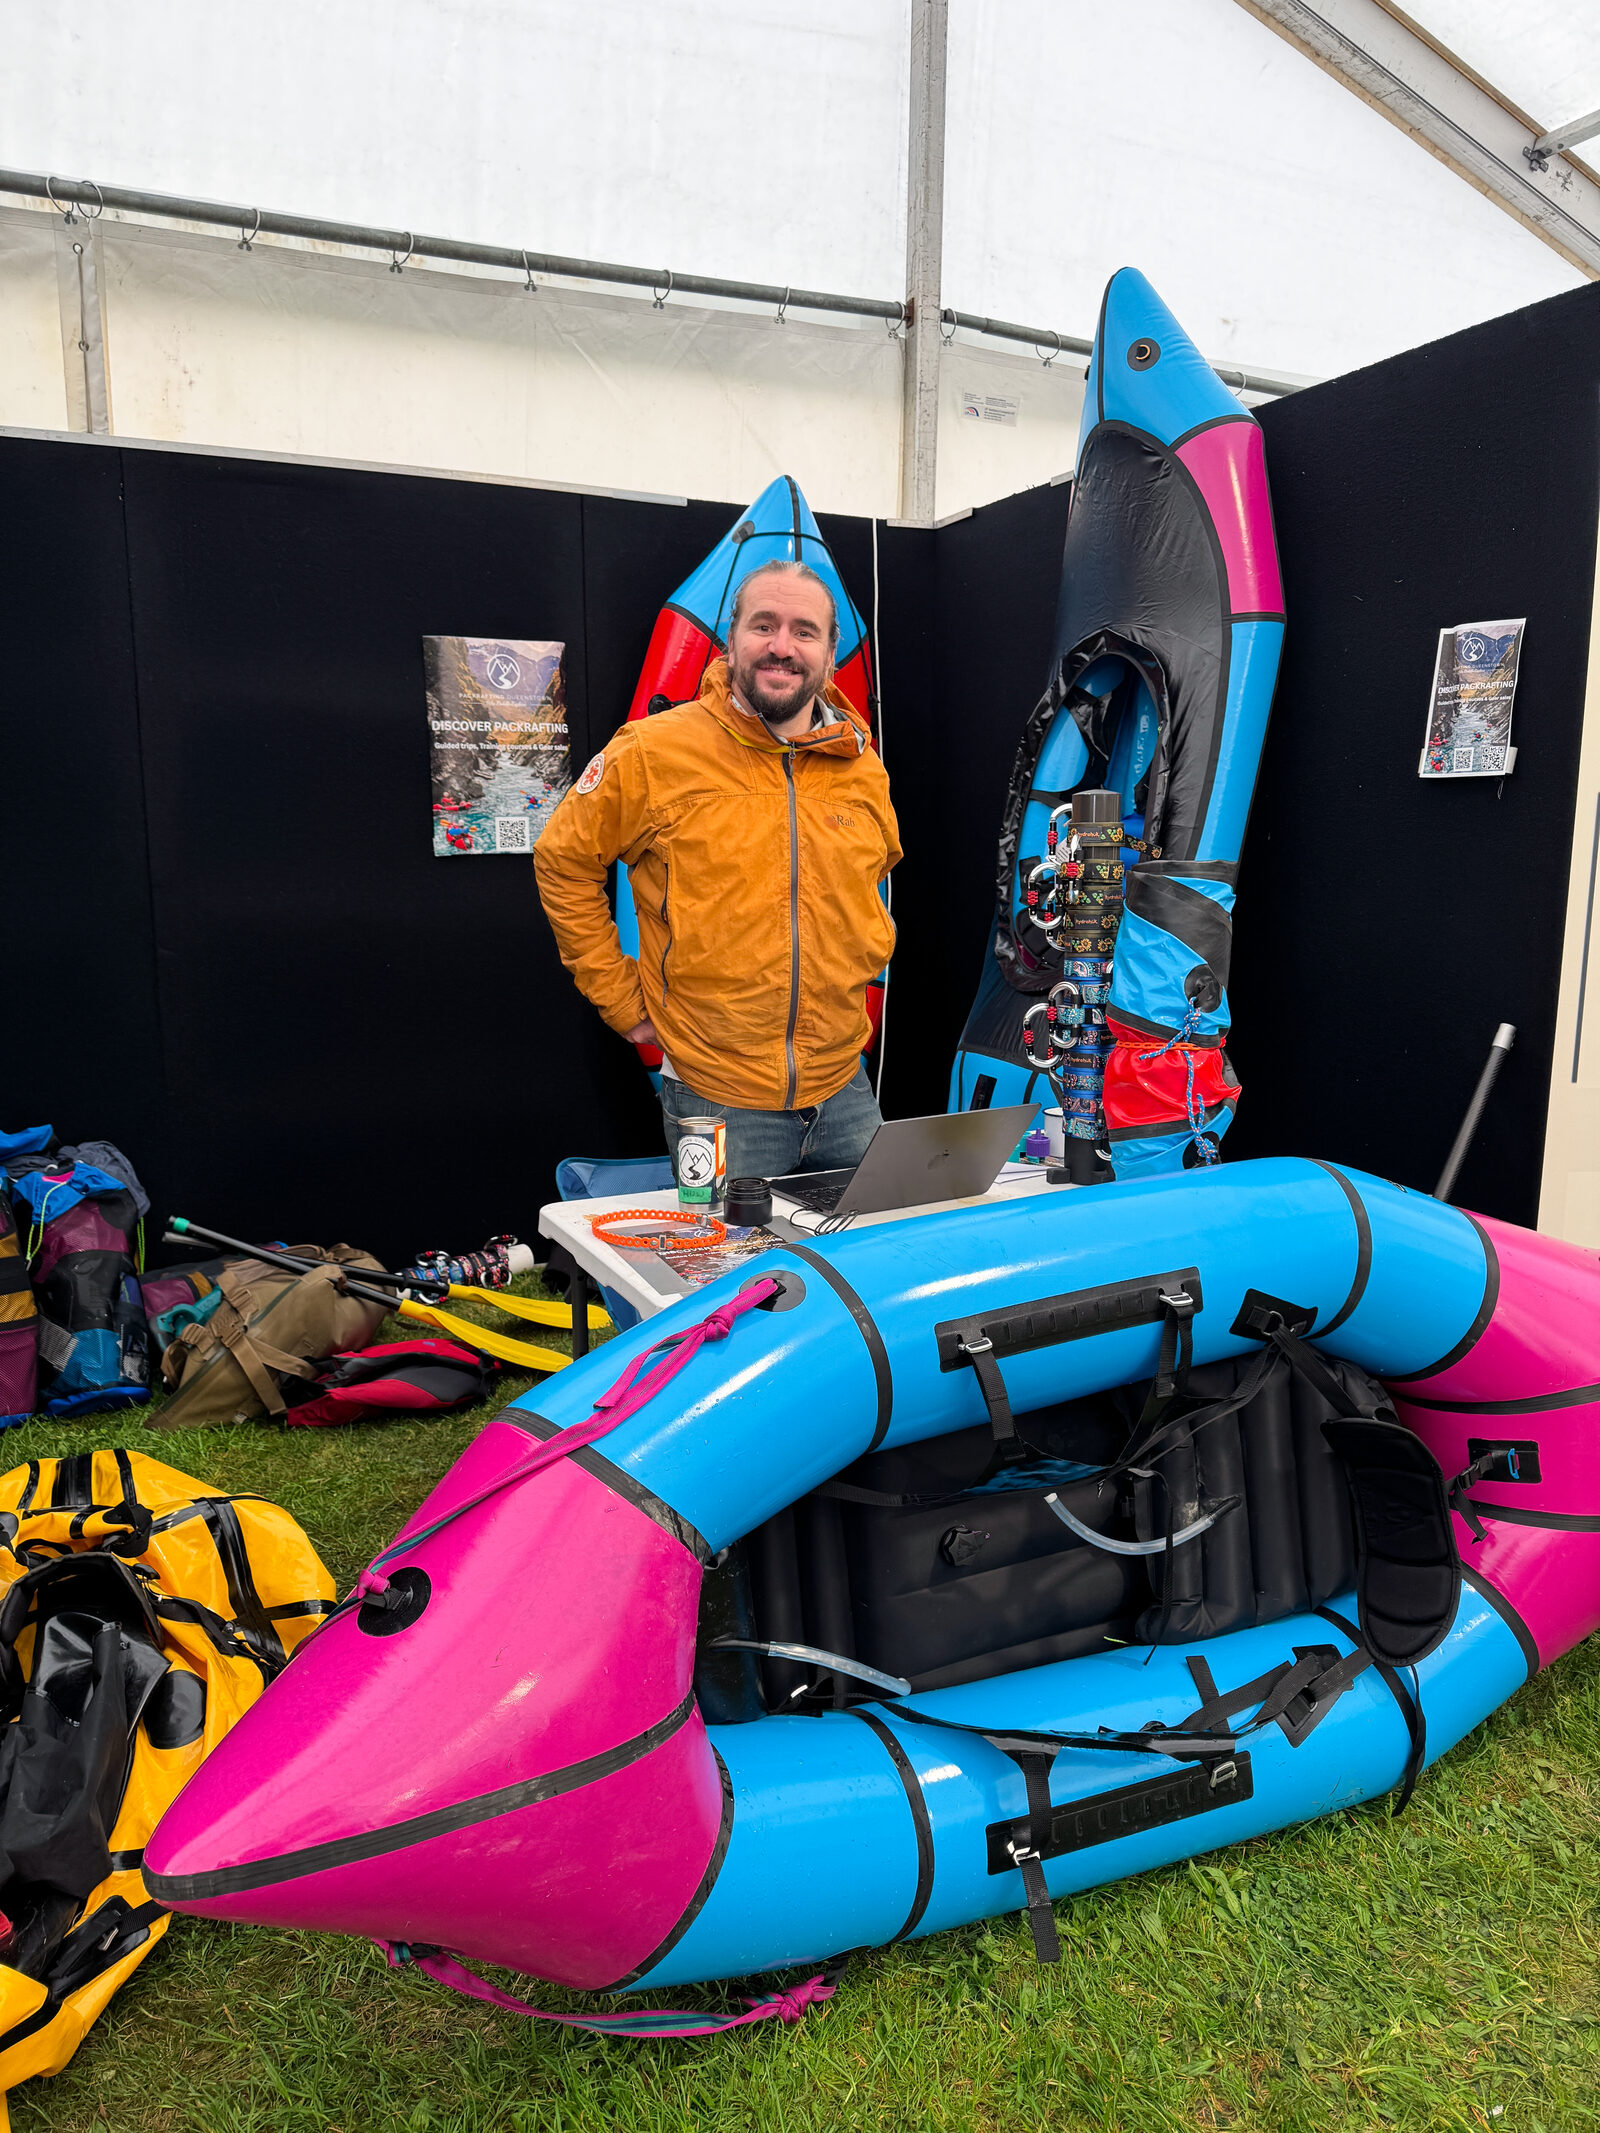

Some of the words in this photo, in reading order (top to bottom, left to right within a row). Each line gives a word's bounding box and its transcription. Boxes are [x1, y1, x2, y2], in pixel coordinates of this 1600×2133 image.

[1460, 680, 1514, 691] PACKRAFTING
[431, 720, 492, 732] DISCOVER
[494, 721, 569, 734] PACKRAFTING
[434, 742, 460, 750] Guided
[460, 743, 479, 751] trips,
[836, 814, 855, 828] Rab
